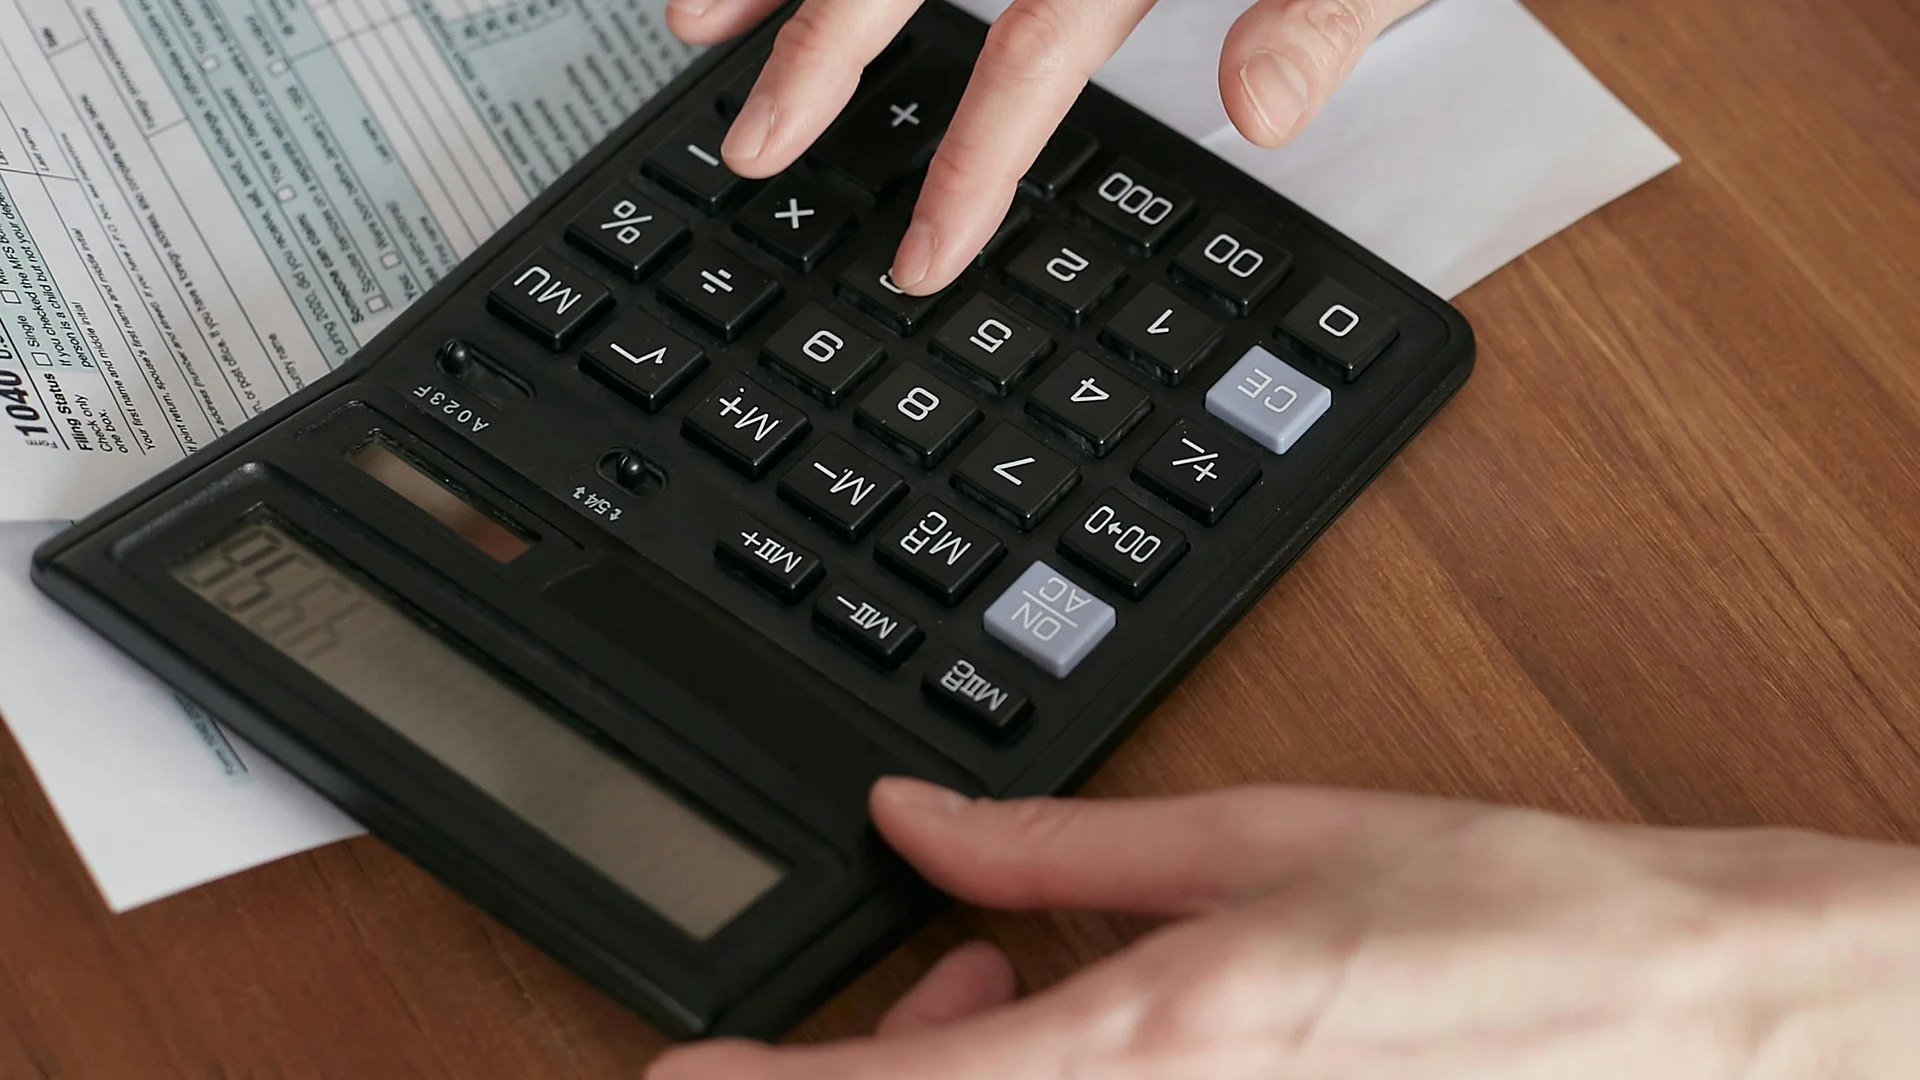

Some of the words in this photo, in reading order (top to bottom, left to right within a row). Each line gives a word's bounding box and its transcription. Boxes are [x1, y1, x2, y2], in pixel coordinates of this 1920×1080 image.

[1098, 172, 1174, 225] 000
[9, 222, 31, 243] your
[2, 247, 22, 268] MFS
[21, 246, 37, 262] not
[1046, 247, 1090, 283] 2
[1204, 234, 1265, 279] 00
[19, 274, 32, 288] the
[32, 267, 47, 281] but
[39, 285, 60, 309] child
[102, 285, 118, 301] and
[329, 270, 364, 324] Someone
[513, 266, 583, 315] MU
[25, 292, 56, 335] checked
[56, 311, 65, 319] a
[60, 321, 71, 330] is
[71, 302, 91, 325] initial
[114, 304, 132, 328] name
[202, 312, 218, 329] you
[1146, 308, 1174, 335] 1
[1317, 303, 1362, 338] 0
[17, 317, 40, 346] Single
[88, 329, 108, 358] middle
[127, 331, 140, 346] first
[969, 319, 1014, 355] 5
[53, 339, 70, 357] you
[67, 333, 94, 367] person
[218, 339, 237, 366] office.
[269, 334, 287, 360] name
[802, 330, 845, 364] 9
[104, 362, 118, 377] and
[138, 351, 165, 389] spouse's
[231, 368, 251, 388] post
[0, 370, 50, 436] 1040
[44, 375, 72, 413] Status
[115, 382, 133, 406] name
[1069, 377, 1112, 403] 4
[1237, 367, 1299, 414] CE
[75, 395, 92, 415] only
[127, 410, 143, 425] first
[163, 393, 182, 422] return,
[200, 391, 224, 425] address
[896, 386, 941, 422] 8
[99, 410, 115, 431] box.
[719, 393, 781, 443] M+
[67, 420, 93, 450] Filing
[88, 422, 112, 451] Check
[111, 435, 128, 453] one
[139, 429, 155, 449] Your
[177, 425, 197, 444] joint
[991, 457, 1037, 487] 7
[1037, 576, 1092, 614] AC
[1011, 600, 1063, 642] ON
